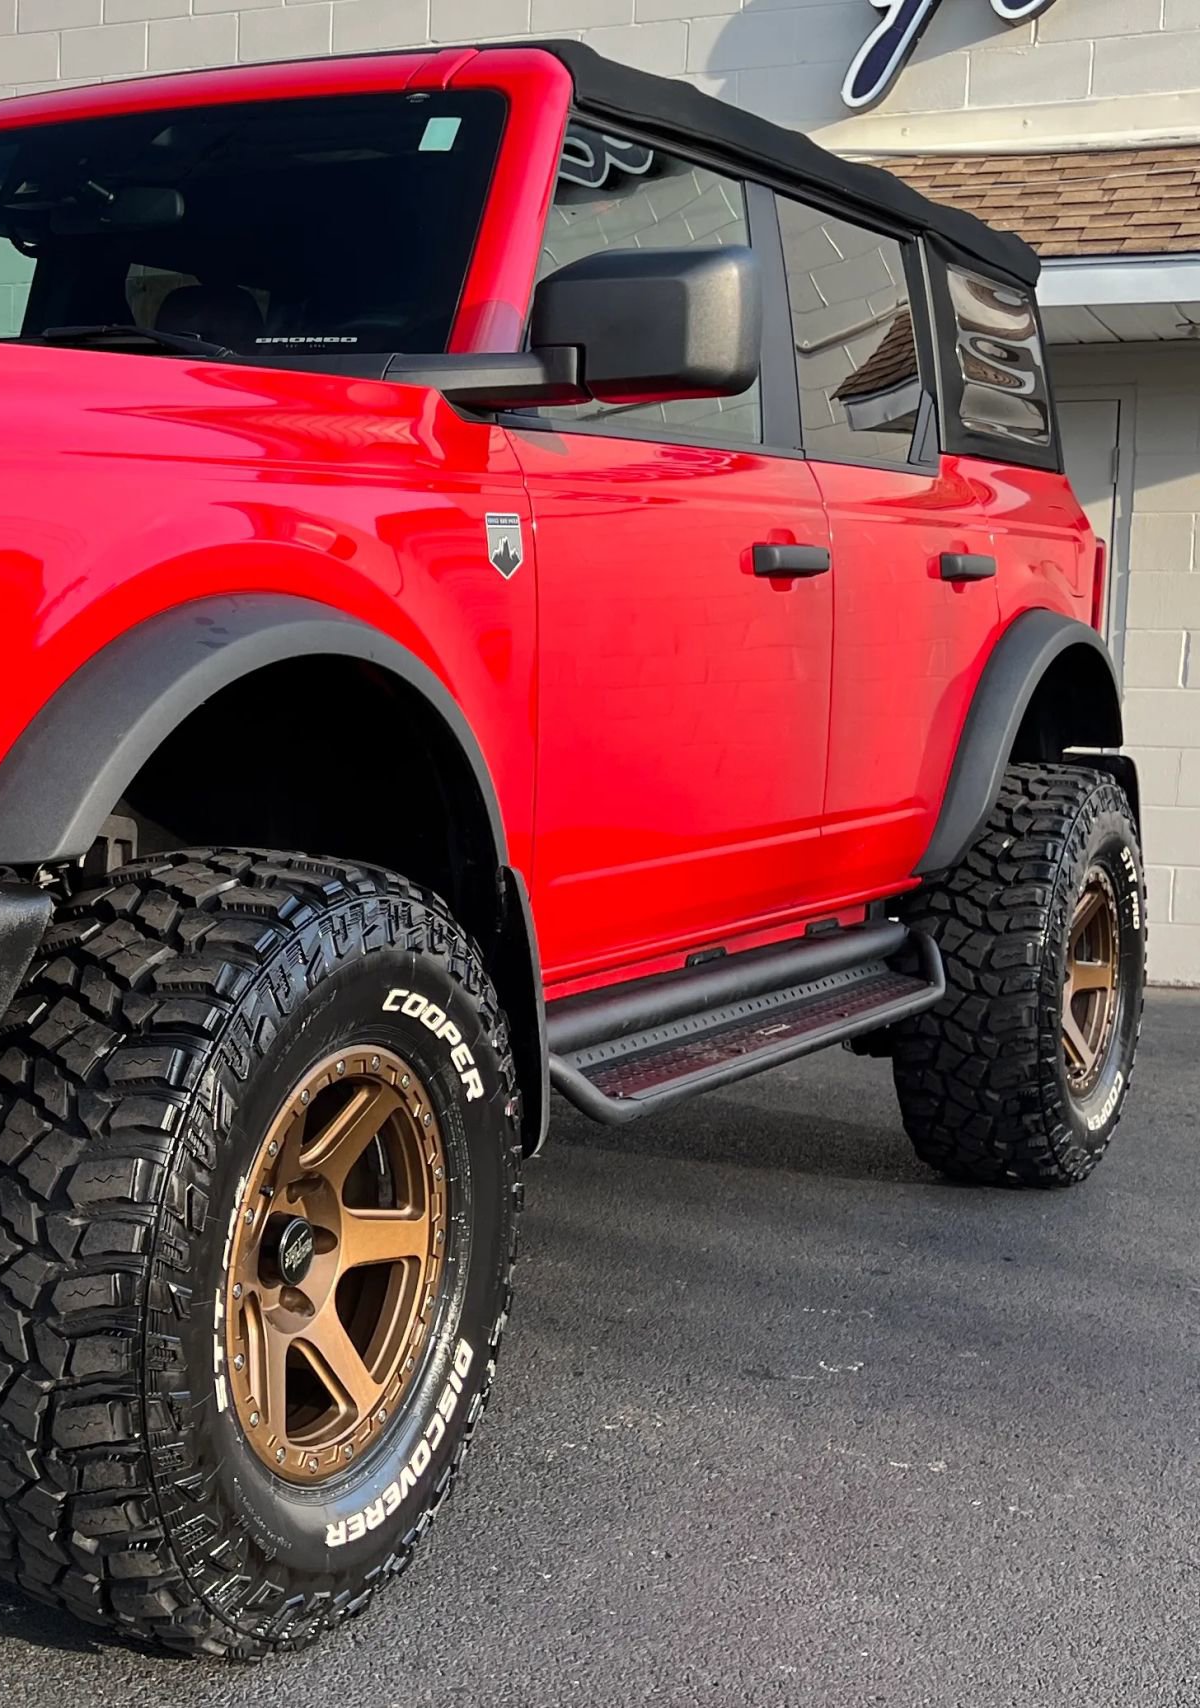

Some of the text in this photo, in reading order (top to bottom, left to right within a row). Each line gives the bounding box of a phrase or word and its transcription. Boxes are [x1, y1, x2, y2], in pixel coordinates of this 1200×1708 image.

[1120, 846, 1137, 887] STT
[382, 987, 484, 1102] COOPER
[1087, 1072, 1124, 1132] COOPER
[324, 1339, 474, 1549] DISCOVERER
